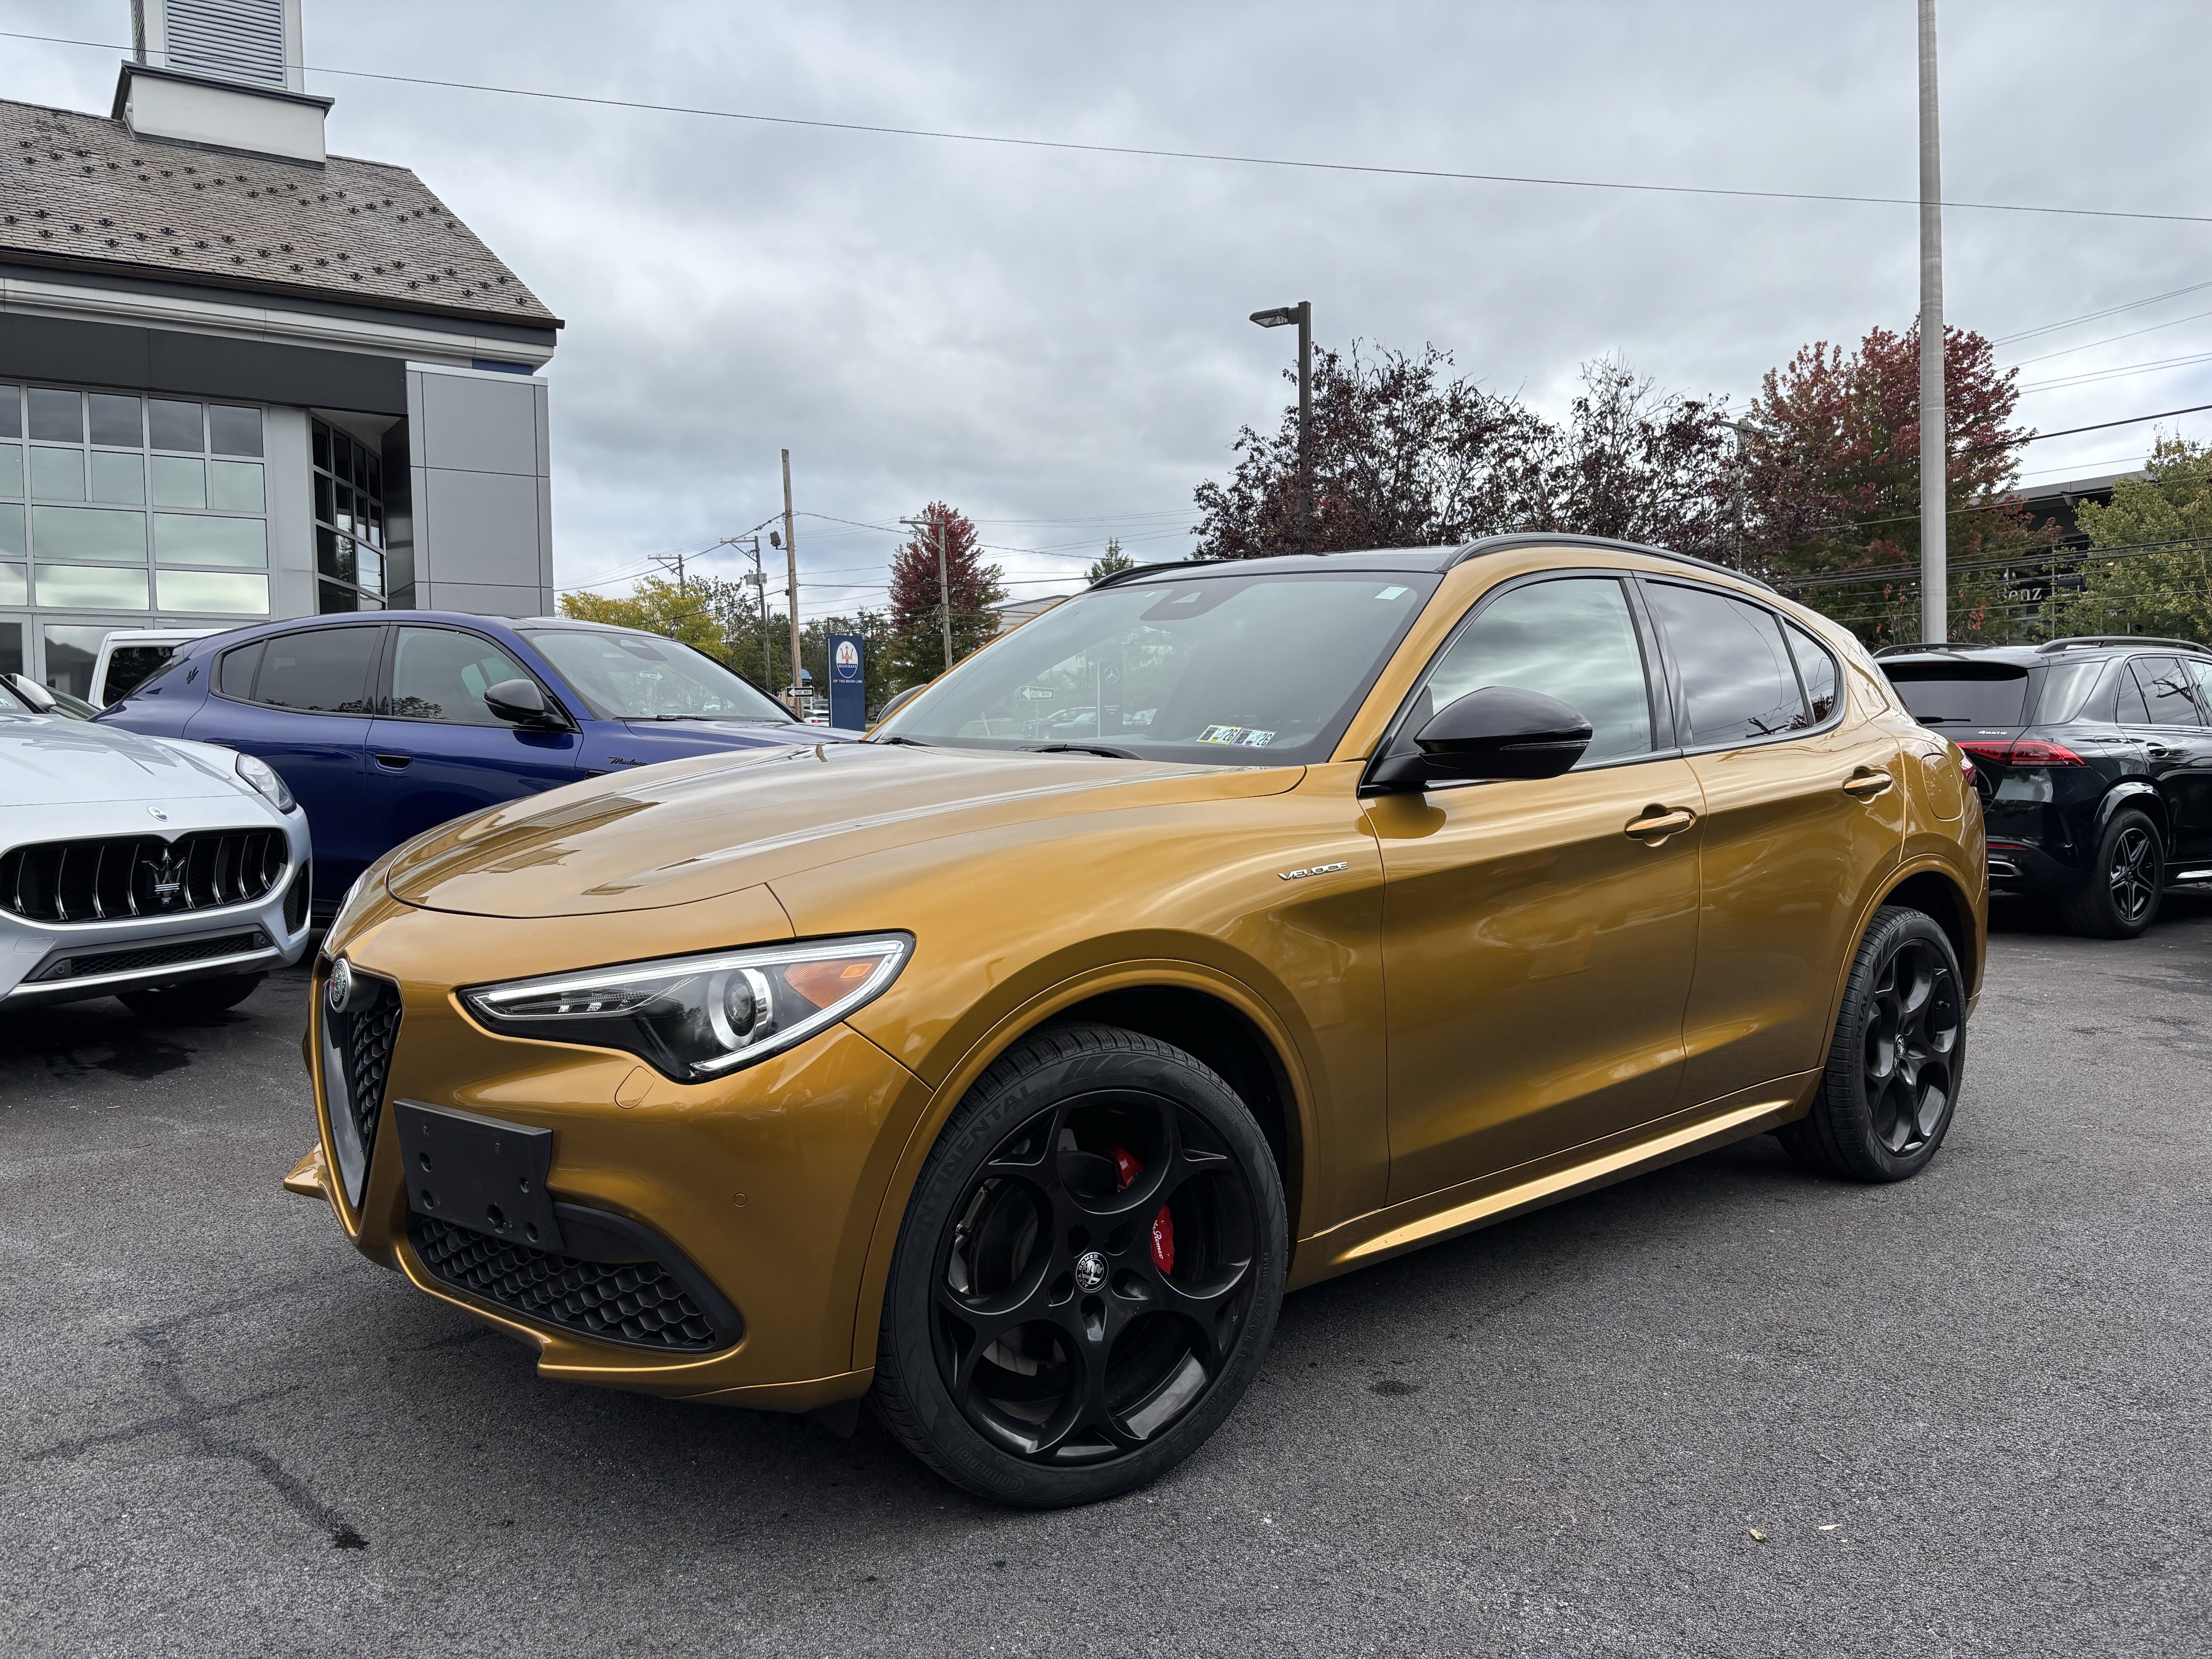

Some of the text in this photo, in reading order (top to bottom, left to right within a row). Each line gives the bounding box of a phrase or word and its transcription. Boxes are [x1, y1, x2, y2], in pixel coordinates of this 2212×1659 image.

[1223, 728, 1238, 741] 26
[1277, 862, 1348, 881] VELOCE
[907, 1085, 1039, 1268] CONTINENTAL
[1153, 1230, 1164, 1259] Romeo
[1078, 1254, 1098, 1288] ALFA ROMEO
[953, 1446, 1025, 1492] Continental
